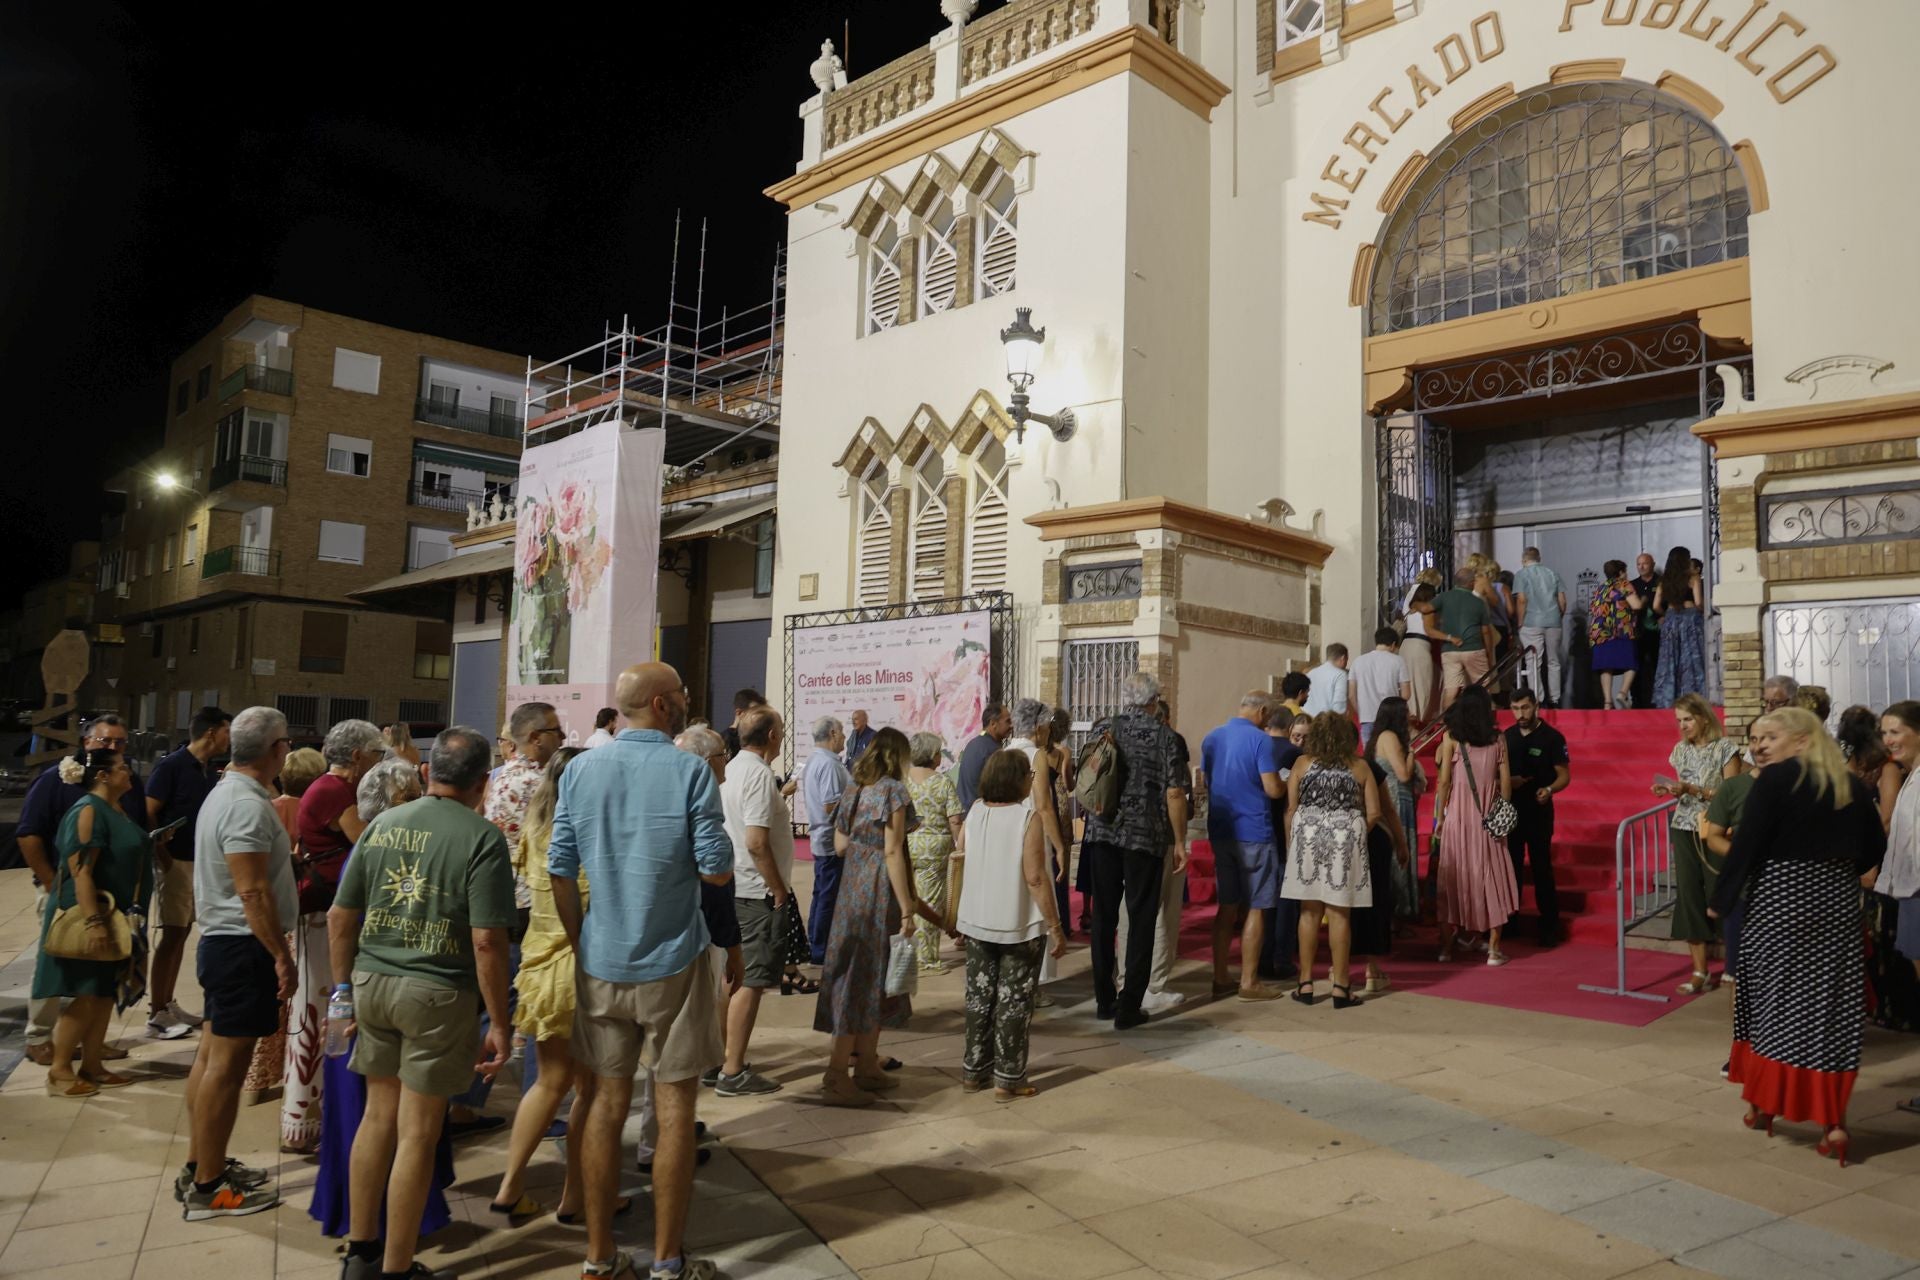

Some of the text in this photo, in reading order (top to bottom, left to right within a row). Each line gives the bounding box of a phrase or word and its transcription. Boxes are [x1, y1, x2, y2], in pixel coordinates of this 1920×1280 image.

[1302, 11, 1505, 230] MERCADO
[798, 668, 914, 688] Cante de las Minas
[387, 827, 433, 853] START
[376, 908, 401, 929] The
